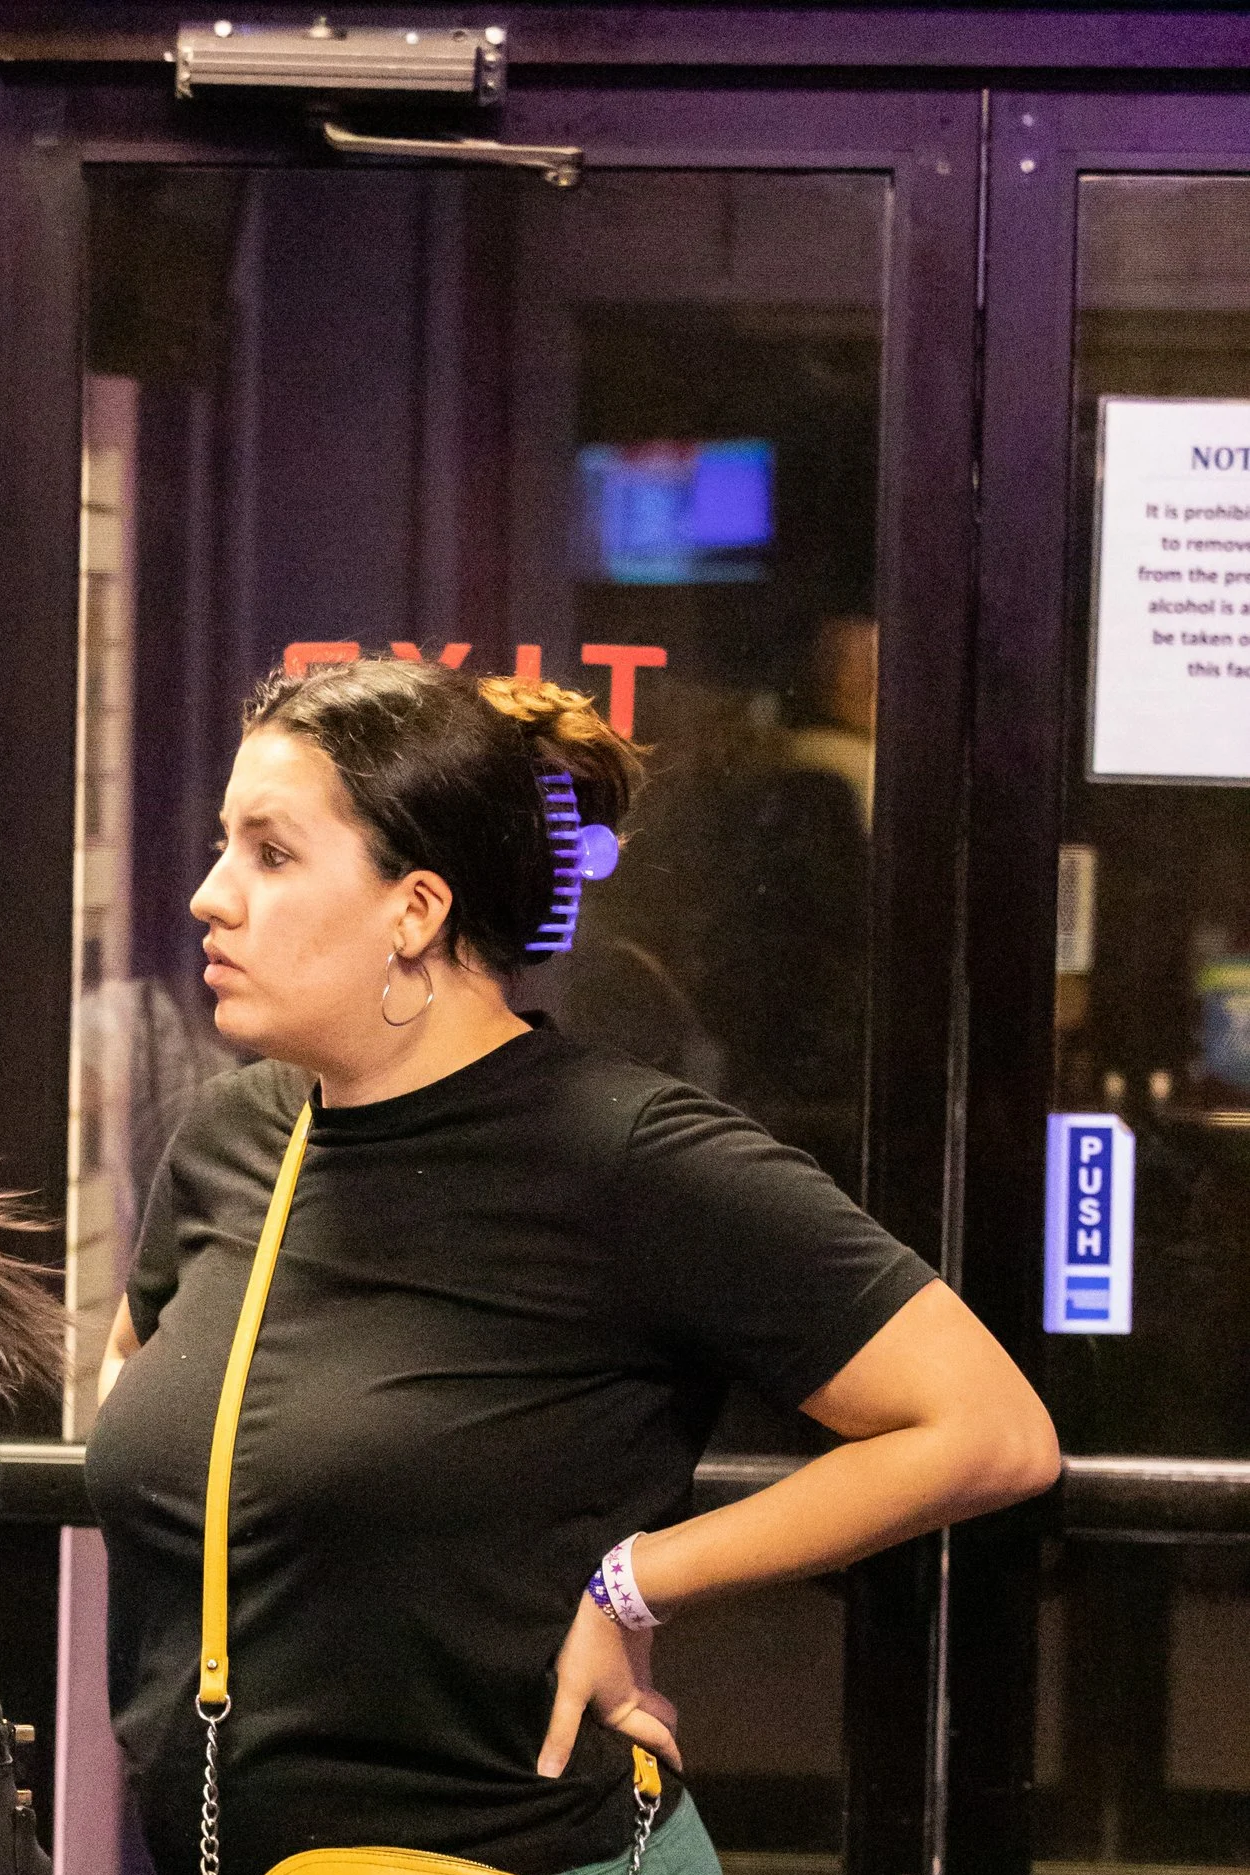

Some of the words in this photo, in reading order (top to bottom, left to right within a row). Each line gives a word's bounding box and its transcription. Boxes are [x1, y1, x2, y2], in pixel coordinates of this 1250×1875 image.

[1165, 504, 1177, 519] is
[1162, 537, 1180, 551] to
[1138, 566, 1182, 582] from
[1188, 567, 1217, 583] the
[1148, 599, 1215, 615] alcohol
[1221, 600, 1234, 616] is
[1153, 629, 1174, 645] be
[1182, 630, 1233, 646] taken
[1188, 661, 1220, 677] this
[1077, 1135, 1102, 1257] PUSH
